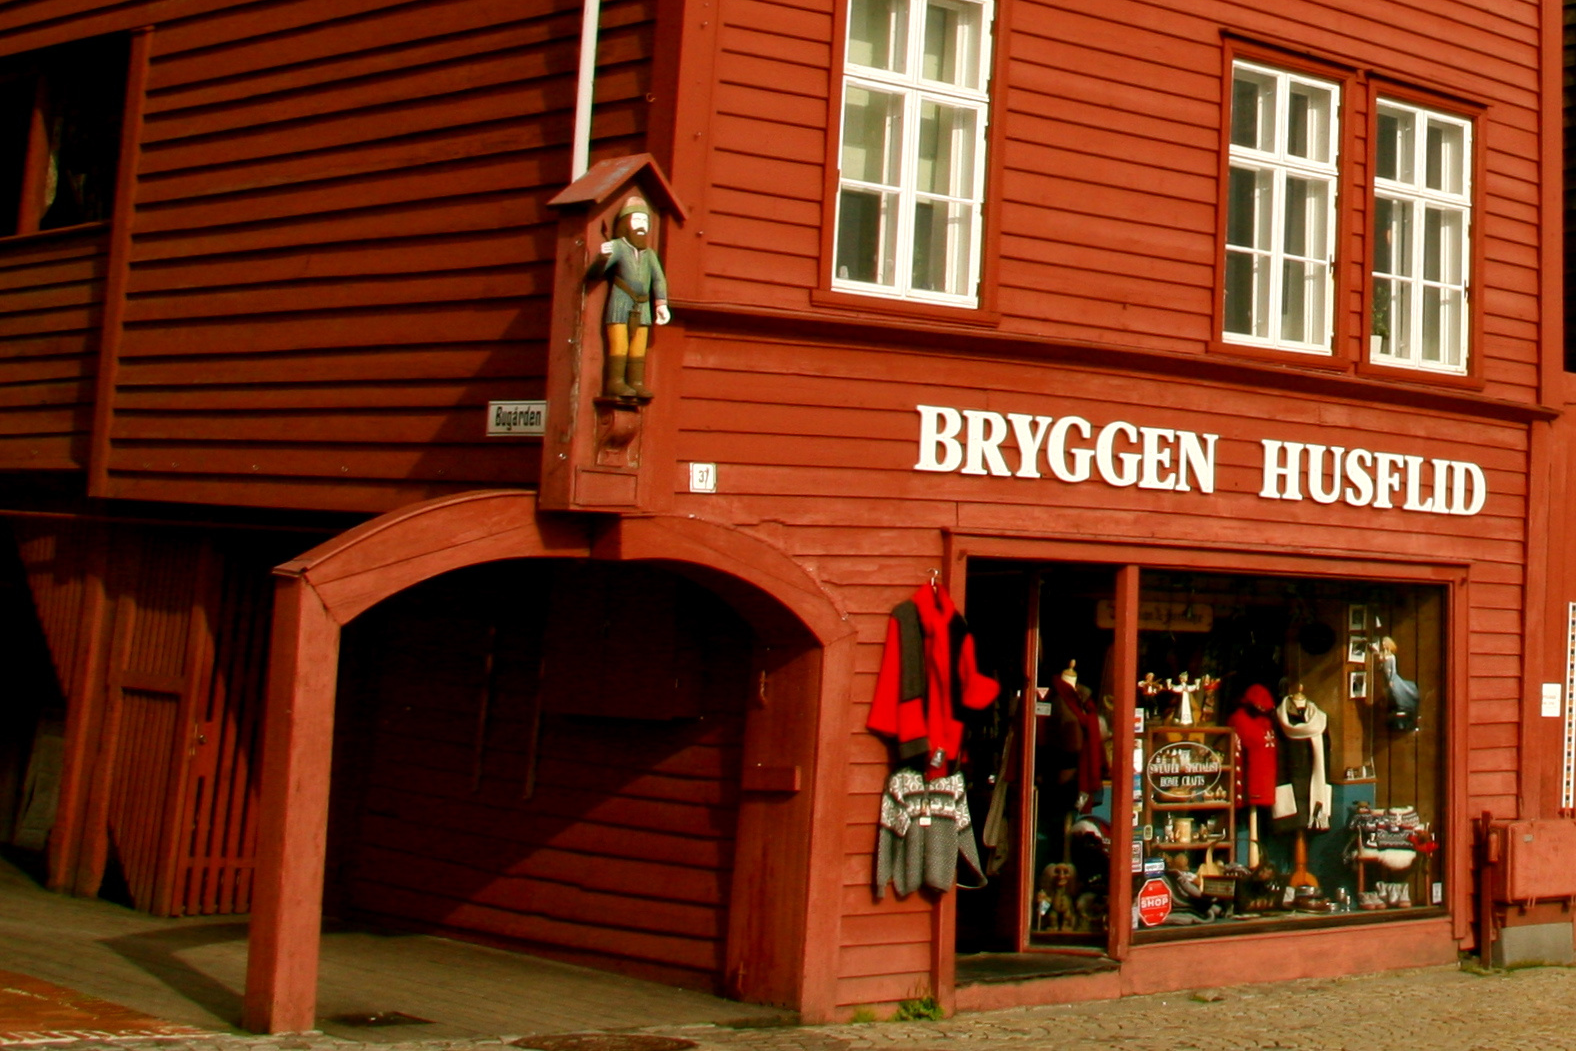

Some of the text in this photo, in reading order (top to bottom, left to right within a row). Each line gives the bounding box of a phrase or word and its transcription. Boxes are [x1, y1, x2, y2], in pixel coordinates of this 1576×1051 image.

[913, 403, 1487, 517] BRYGGEN HUSFLID
[1160, 775, 1205, 787] HOME CRAFTS
[1141, 896, 1168, 909] SHOP
